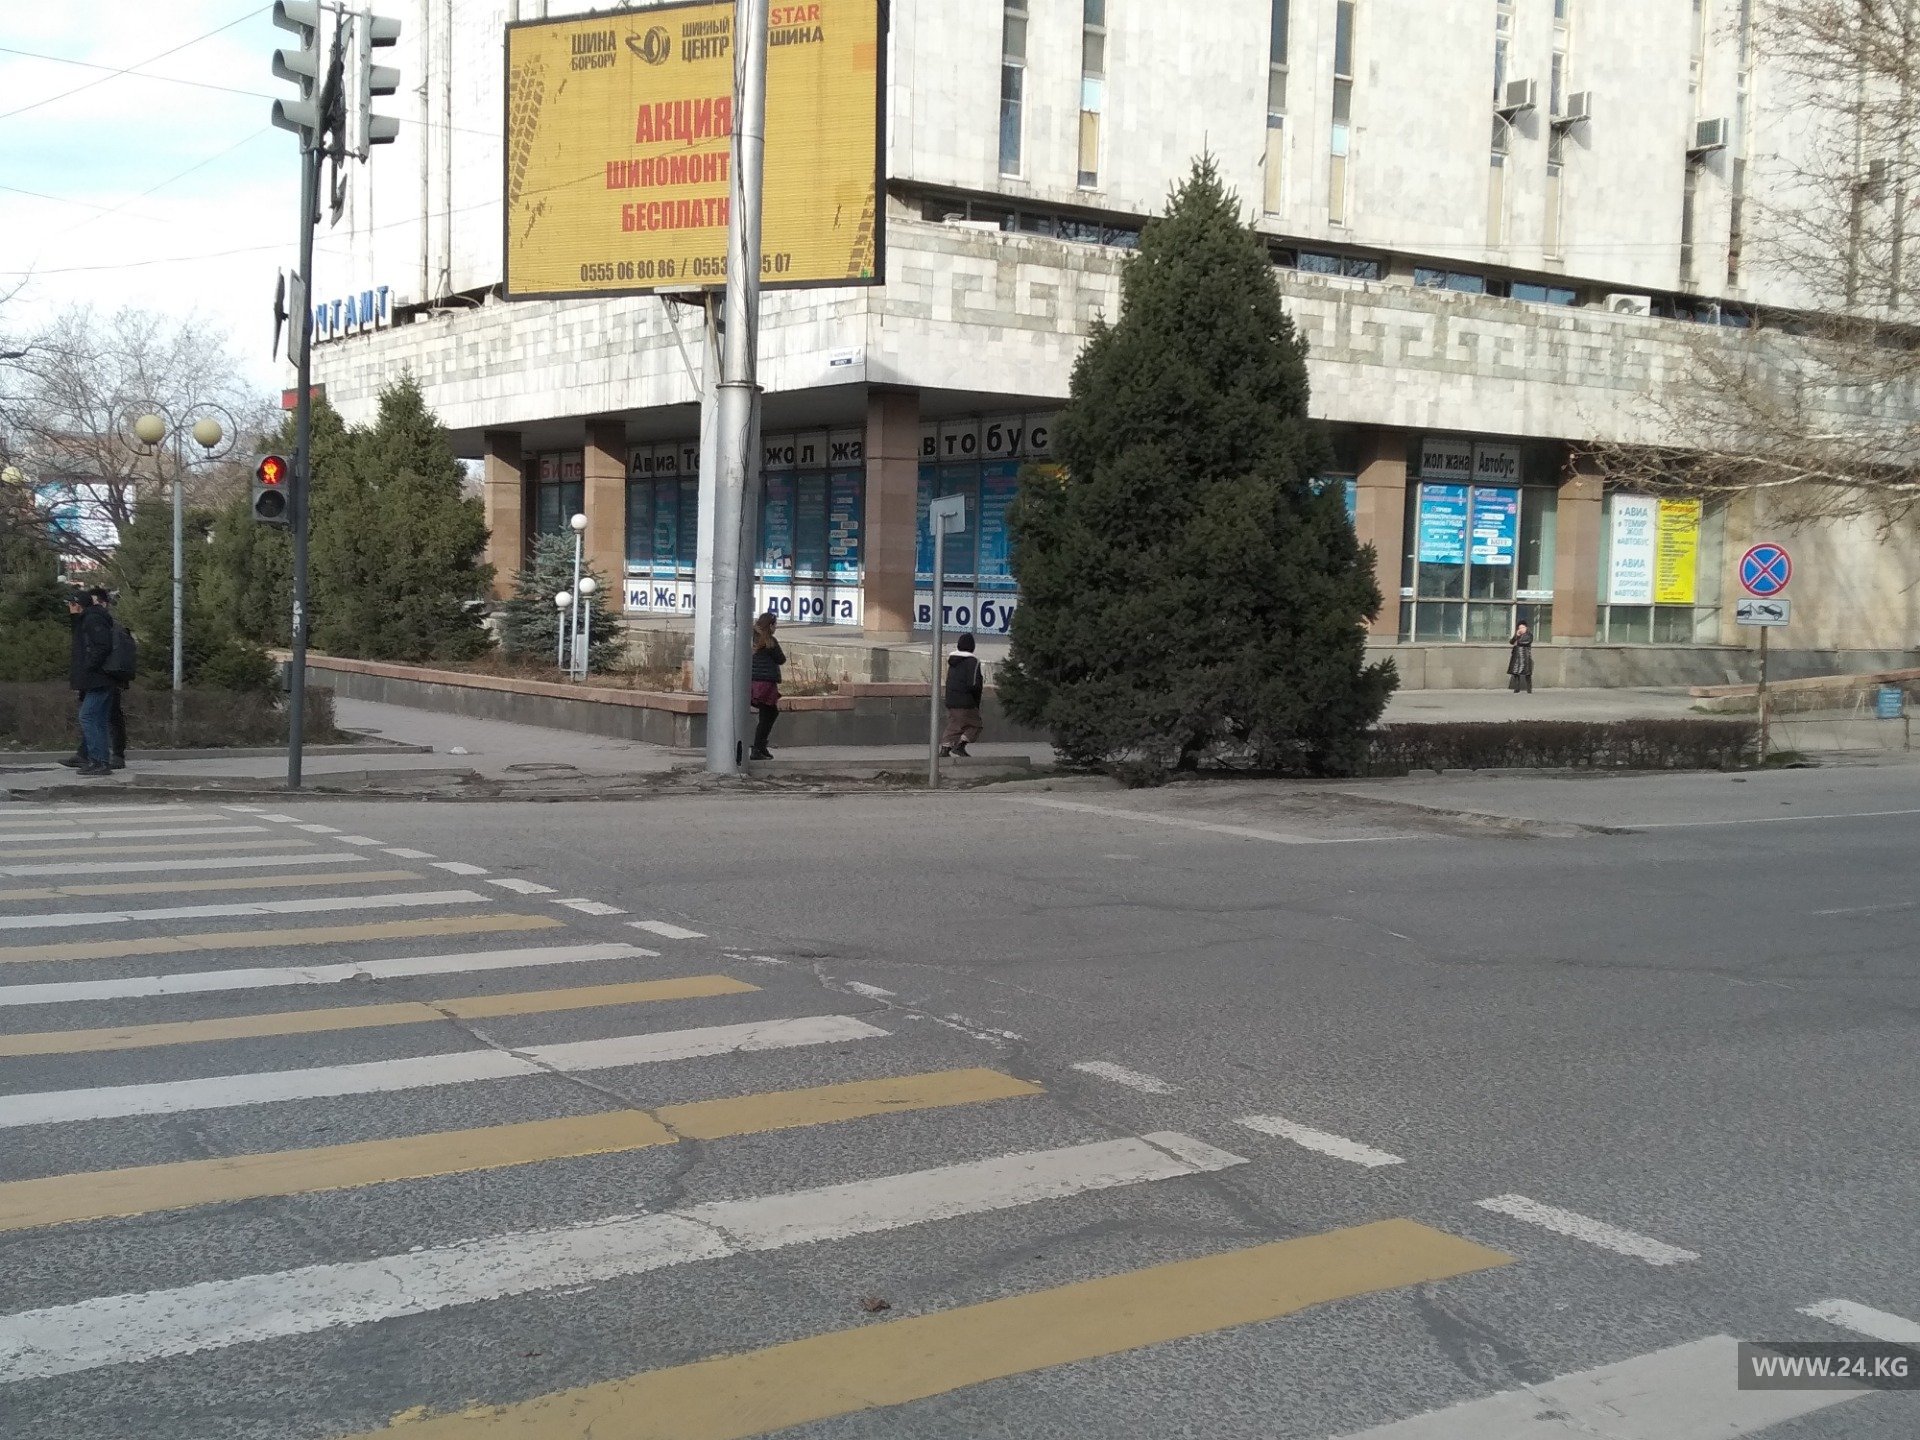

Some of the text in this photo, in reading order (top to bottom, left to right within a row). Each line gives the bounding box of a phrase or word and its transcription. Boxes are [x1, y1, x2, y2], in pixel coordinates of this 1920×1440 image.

[771, 4, 820, 24] STAR
[682, 16, 730, 37] ШИННЫЙ
[769, 26, 825, 47] ШИНА
[571, 30, 617, 56] ШИНА
[682, 36, 730, 63] ЦЕНТР
[571, 53, 617, 71] БОРБОРУ
[636, 96, 732, 146] АКЦИЯ
[580, 263, 614, 282] 0555
[617, 262, 634, 280] 06
[638, 260, 654, 279] 80
[658, 259, 675, 278] 86
[693, 256, 727, 276] 0553
[775, 254, 791, 272] 07
[309, 286, 389, 334] ЧТАМТ
[766, 445, 815, 465] жол
[918, 424, 1048, 456] втобус
[1424, 452, 1515, 478] жол жана Автобус
[1624, 507, 1648, 517] АВИА
[1624, 519, 1647, 528] ТЕМИР
[1621, 538, 1649, 546] АВТОБУС
[1621, 559, 1646, 568] АВИА
[768, 596, 853, 620] дорога
[914, 600, 1015, 633] втобу
